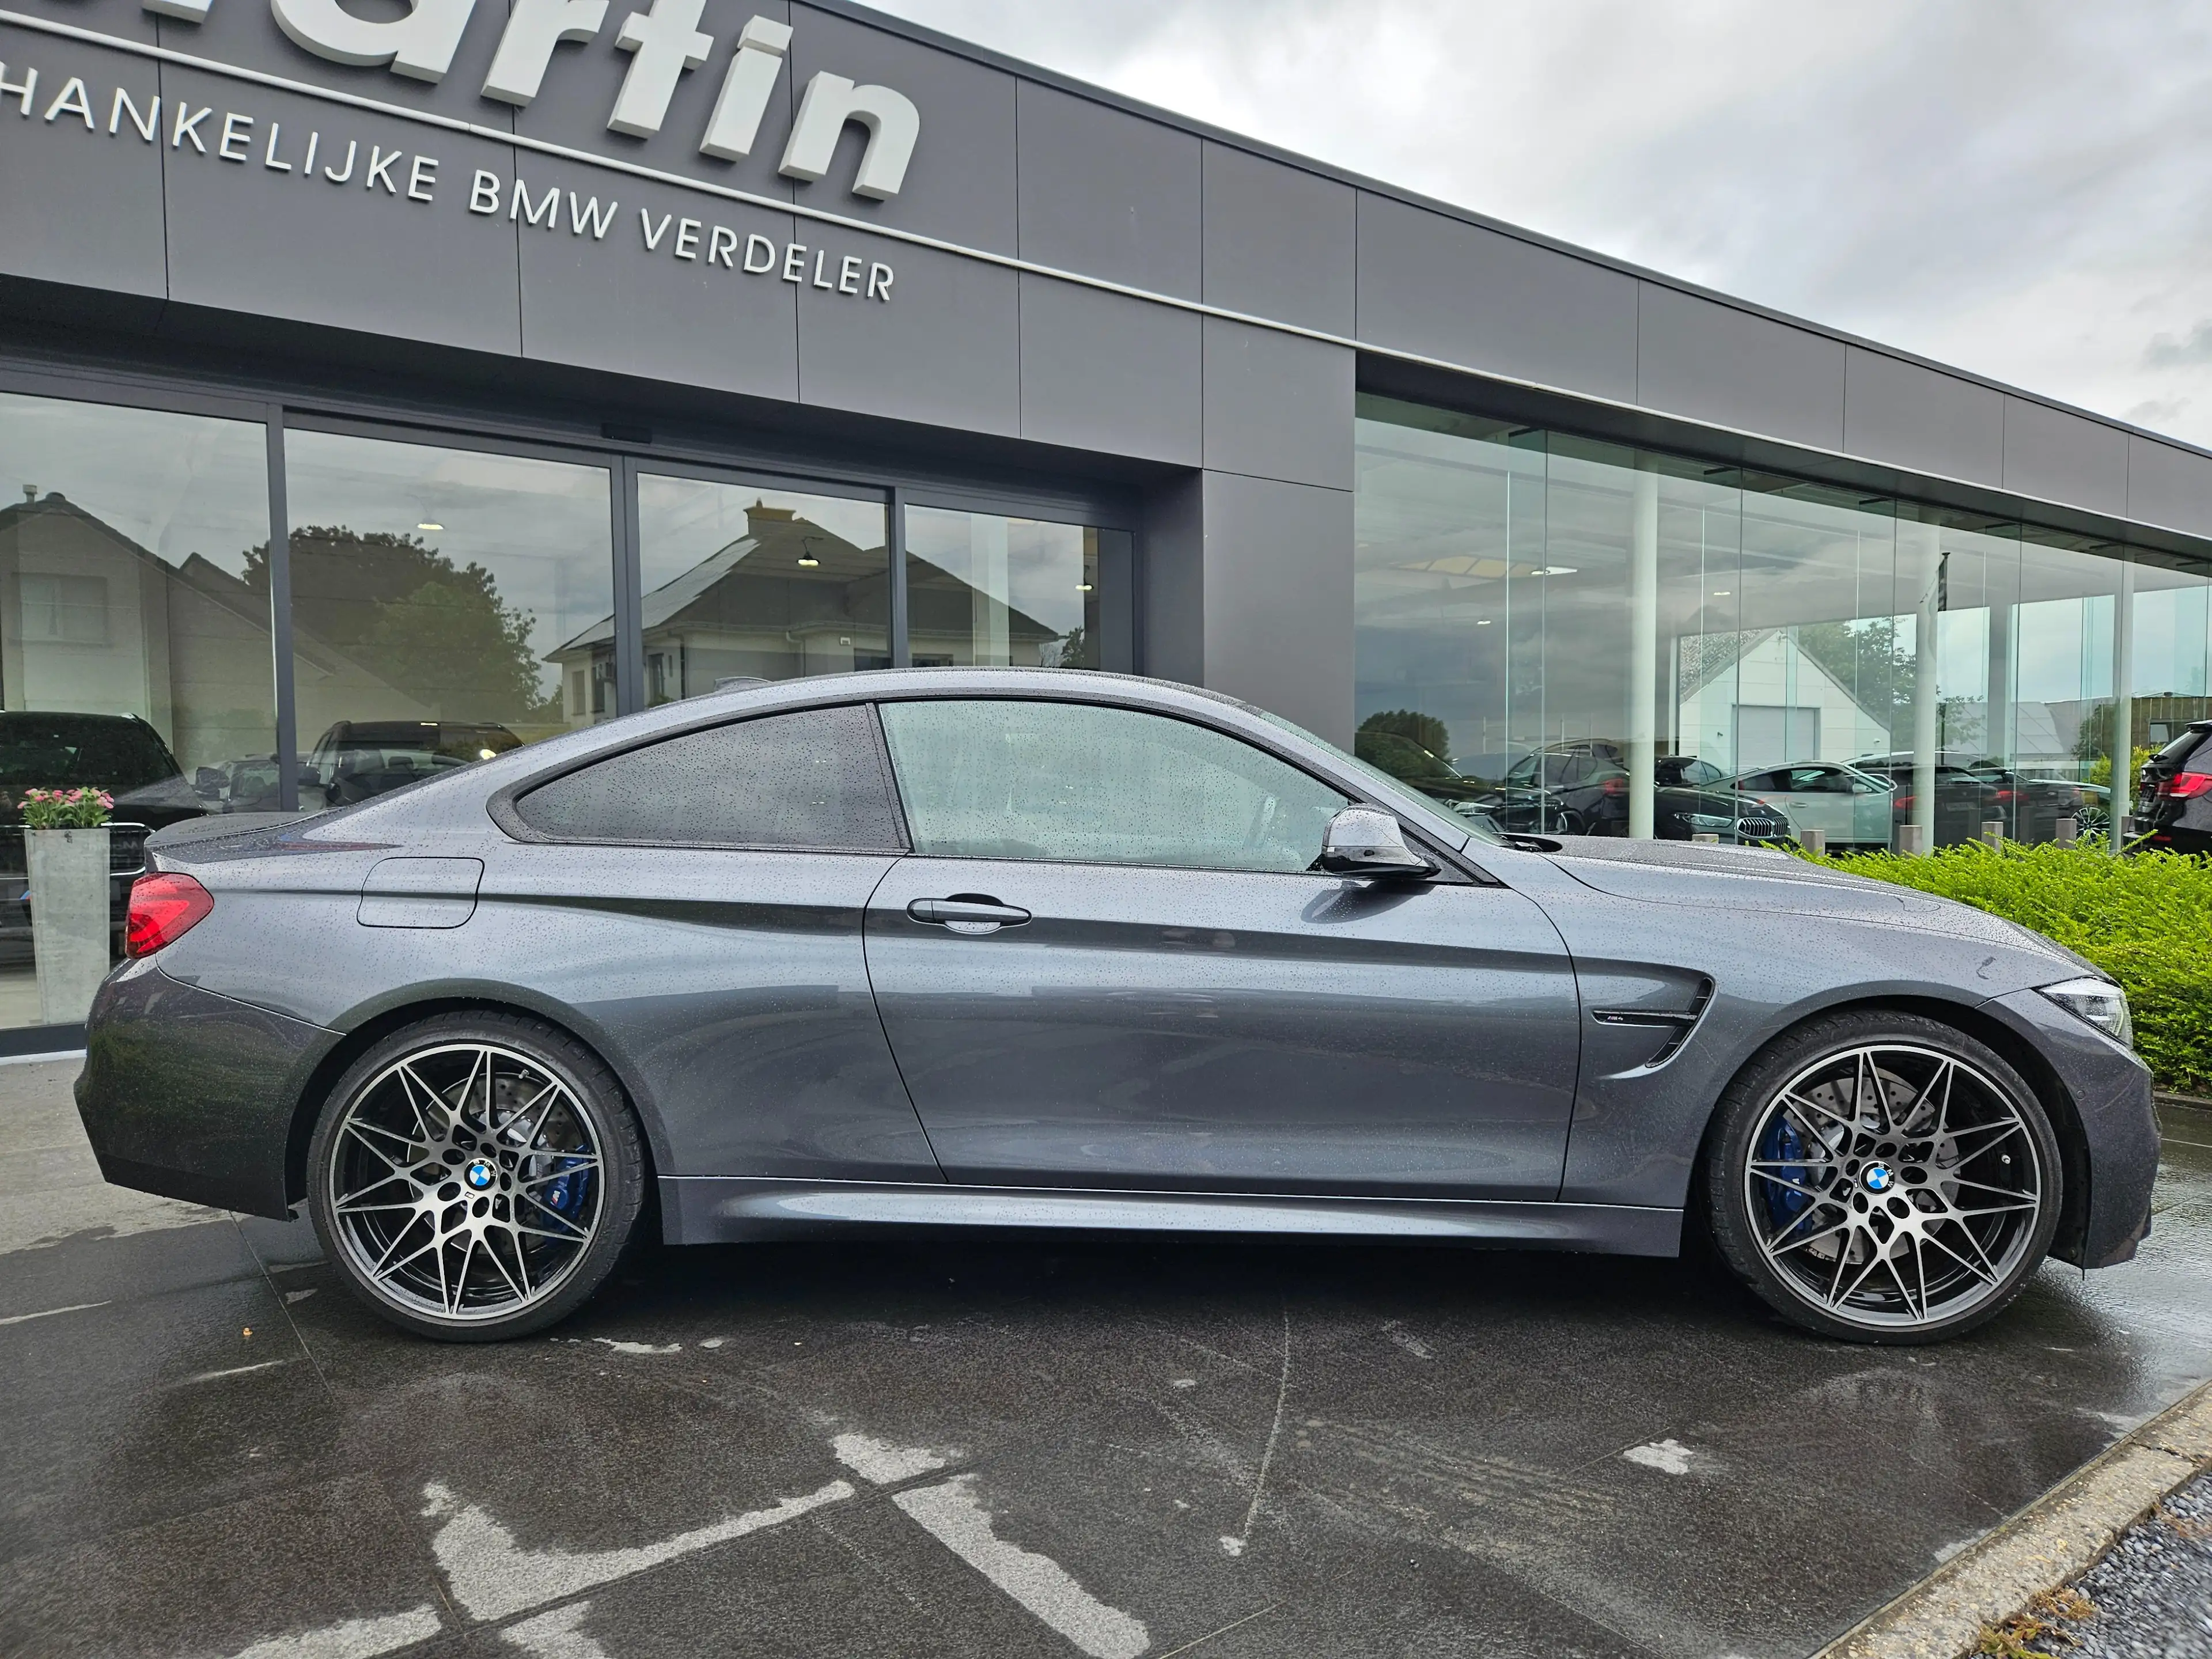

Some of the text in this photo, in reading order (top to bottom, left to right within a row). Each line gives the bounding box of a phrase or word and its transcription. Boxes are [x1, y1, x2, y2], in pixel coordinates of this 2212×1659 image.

[142, 0, 920, 200] artin
[469, 169, 618, 239] BMW
[641, 208, 895, 301] VERDELER
